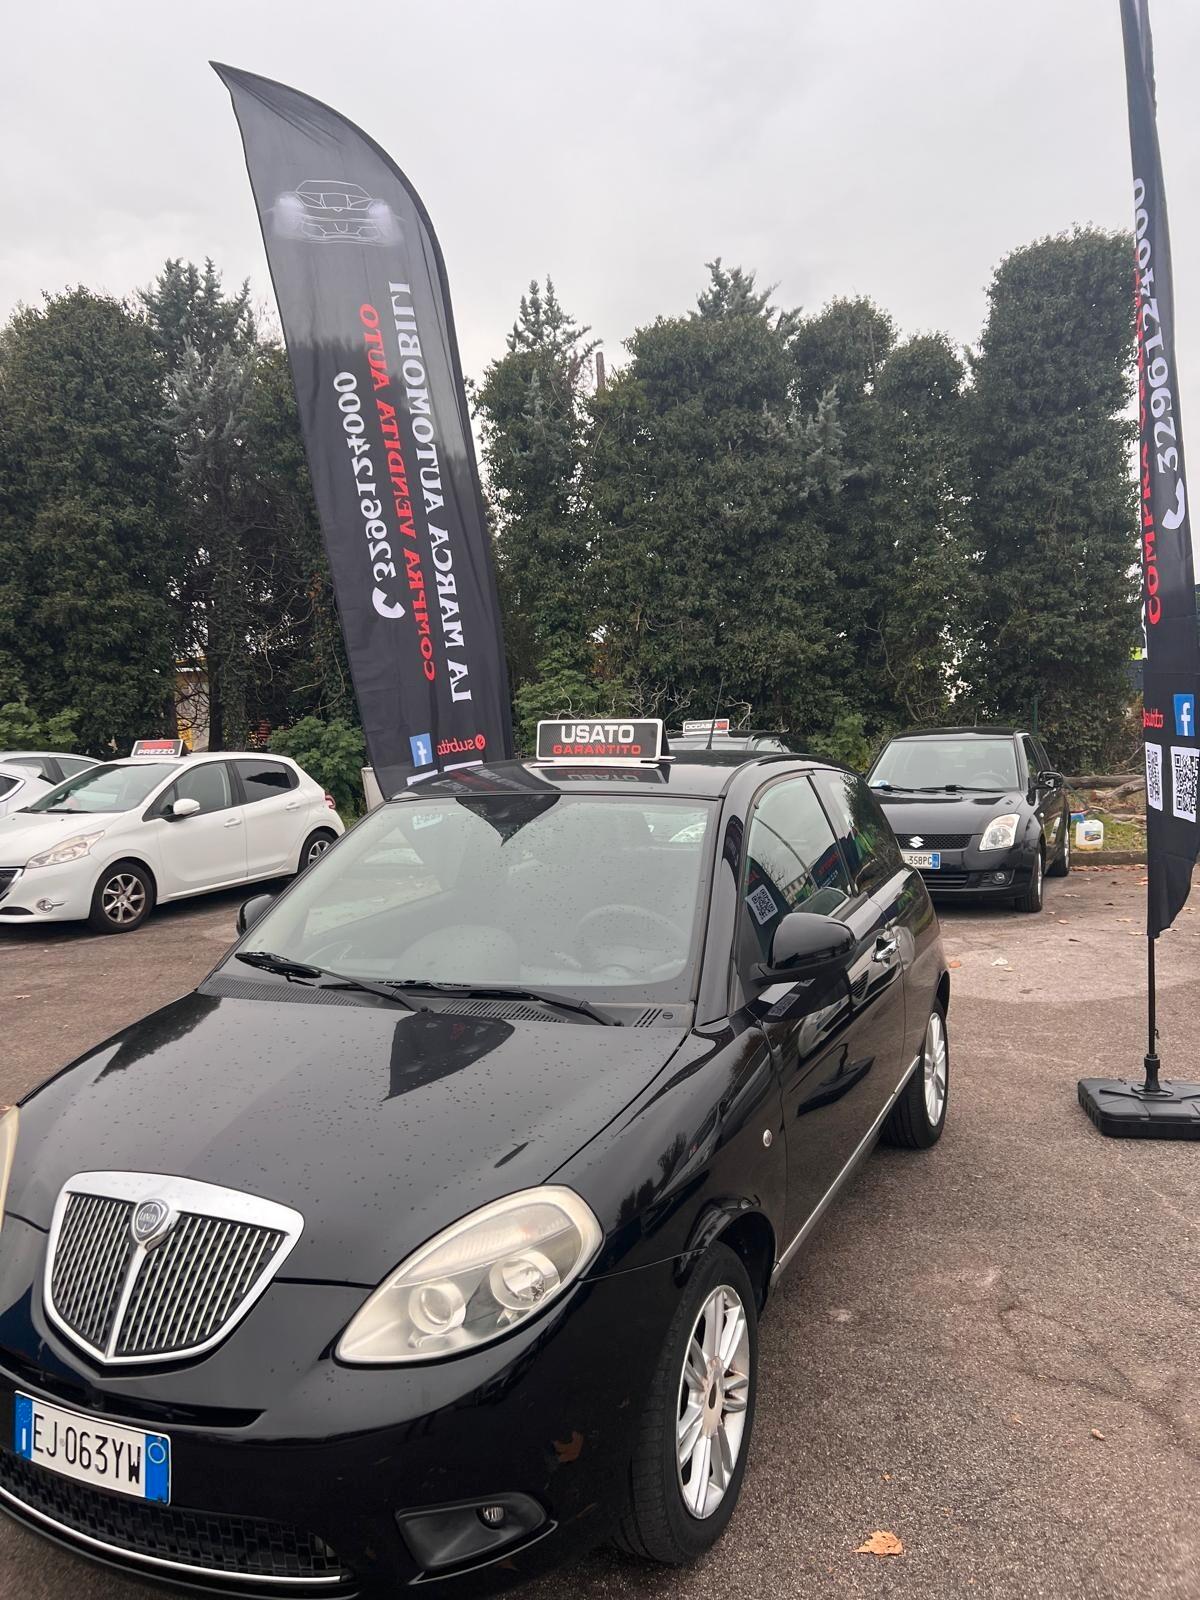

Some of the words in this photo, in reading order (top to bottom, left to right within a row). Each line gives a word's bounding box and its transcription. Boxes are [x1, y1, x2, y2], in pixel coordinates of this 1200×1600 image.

[1133, 177, 1179, 474] 3296124000
[560, 724, 635, 744] USATO
[552, 744, 641, 756] GARANTITO
